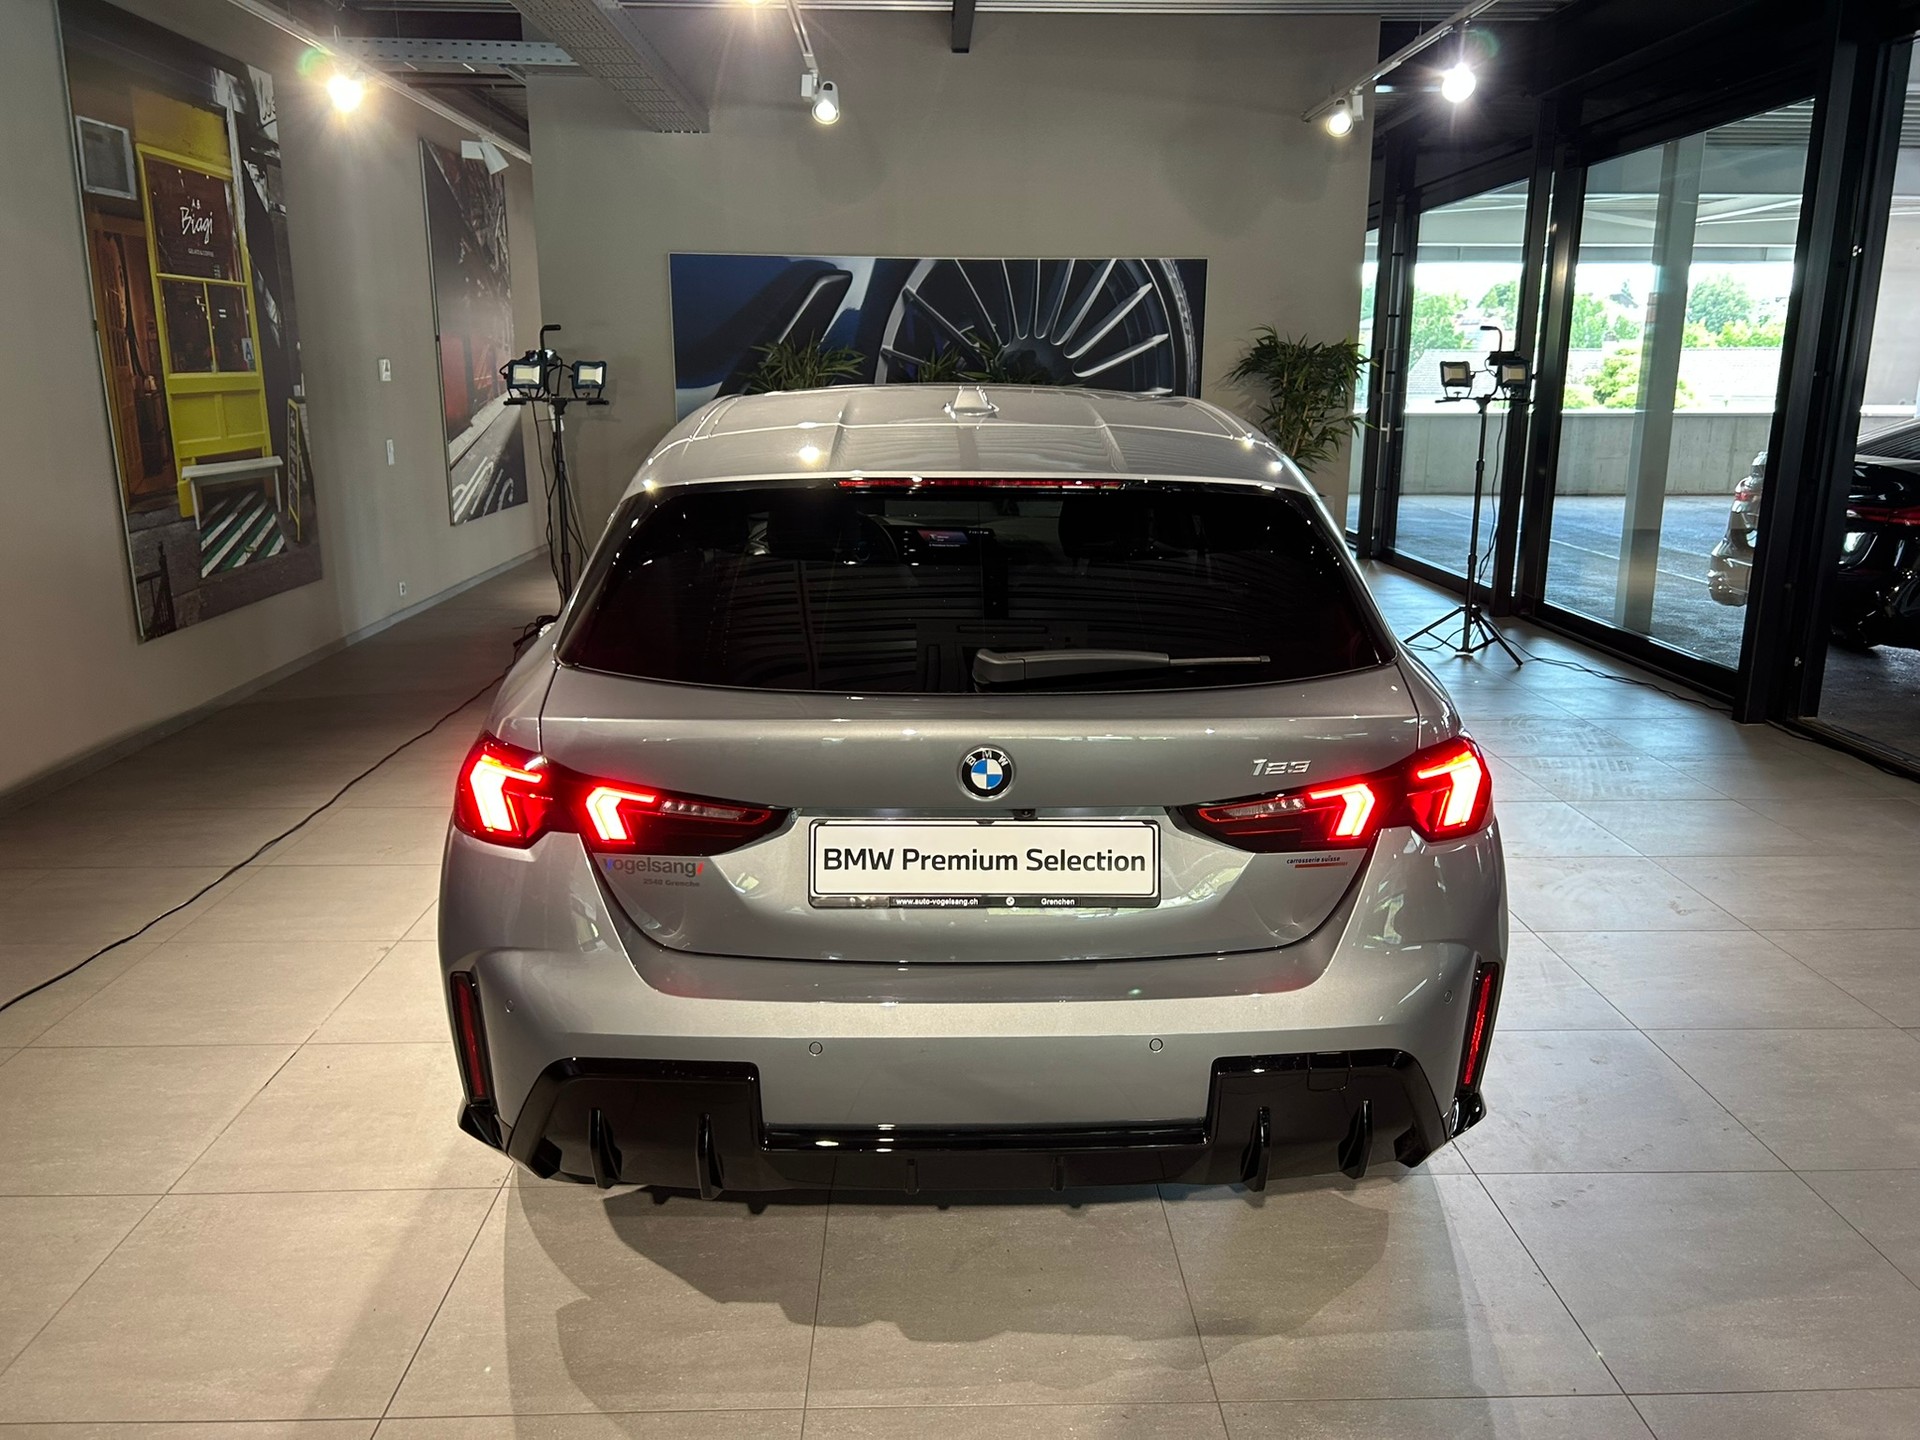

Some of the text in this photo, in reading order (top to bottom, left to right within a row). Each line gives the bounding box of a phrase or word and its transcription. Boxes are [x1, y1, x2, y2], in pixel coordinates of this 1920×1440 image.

[179, 206, 213, 245] Biagi
[965, 749, 1009, 767] BMW
[1251, 758, 1312, 776] 123
[823, 848, 1146, 872] BMW Premium Selection
[895, 897, 1075, 907] www.auto-vogelsang.ch Grenchen
